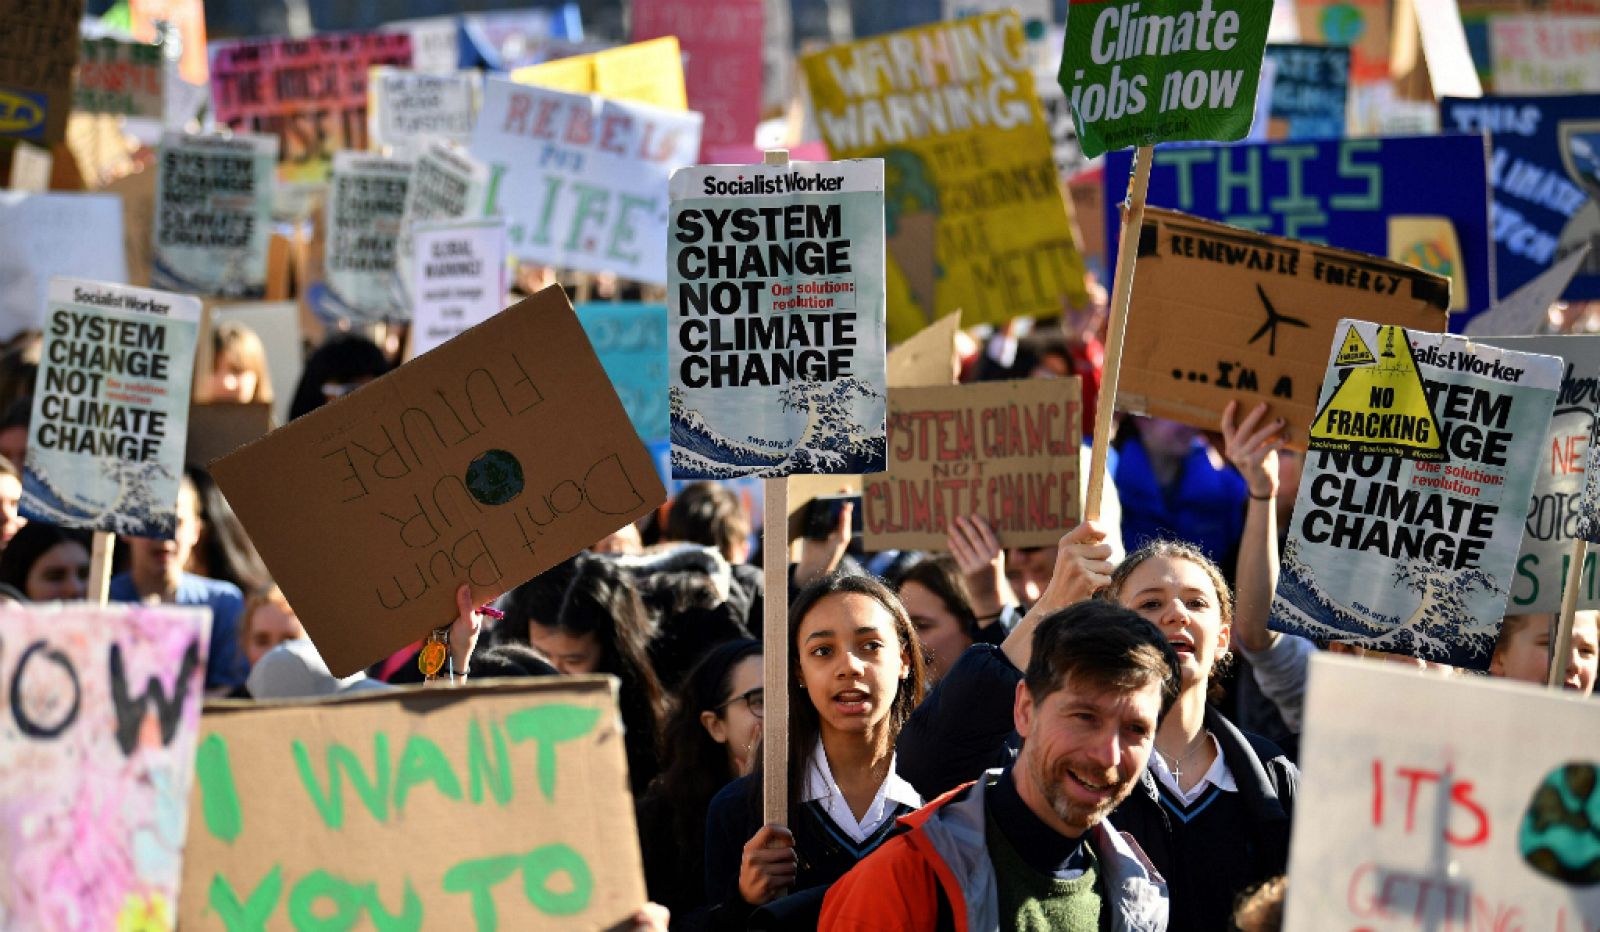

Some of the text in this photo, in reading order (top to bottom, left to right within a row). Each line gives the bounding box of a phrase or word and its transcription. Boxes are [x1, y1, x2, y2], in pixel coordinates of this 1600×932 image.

[1090, 0, 1239, 65] Climate
[1071, 66, 1148, 136] jobs
[1159, 69, 1244, 113] now
[704, 171, 844, 195] Socialist Worker
[1154, 138, 1383, 211] THIS
[675, 204, 841, 243] SYSTEM
[677, 240, 852, 280] CHANGE
[1171, 235, 1404, 296] RENEWABLE ENERGY
[73, 287, 170, 315] Socialist Worker
[679, 281, 765, 316] NOT
[51, 310, 166, 350] SYSTEM
[679, 313, 856, 352] CLIMATE
[48, 338, 170, 380] CHANGE
[680, 349, 854, 388] CHANGE
[1458, 352, 1525, 383] Worker
[45, 366, 103, 398] NOT
[1272, 375, 1293, 399] A
[1369, 385, 1395, 409] NO
[41, 396, 167, 437] CLIMATE
[321, 353, 545, 503] FUTURE
[981, 399, 1080, 458] CHANGE
[1325, 409, 1430, 443] FRACKING
[38, 423, 162, 462] CHANGE
[932, 462, 985, 479] NOT
[1412, 474, 1481, 497] revolution
[1415, 460, 1504, 487] One solution:
[864, 471, 1076, 535] CLIMATE CHANGE
[1311, 473, 1500, 539] CLIMATE
[1302, 509, 1486, 570] CHANGE
[375, 529, 503, 609] Burn
[196, 703, 602, 843] I WANT
[205, 843, 595, 932] YOU TO
